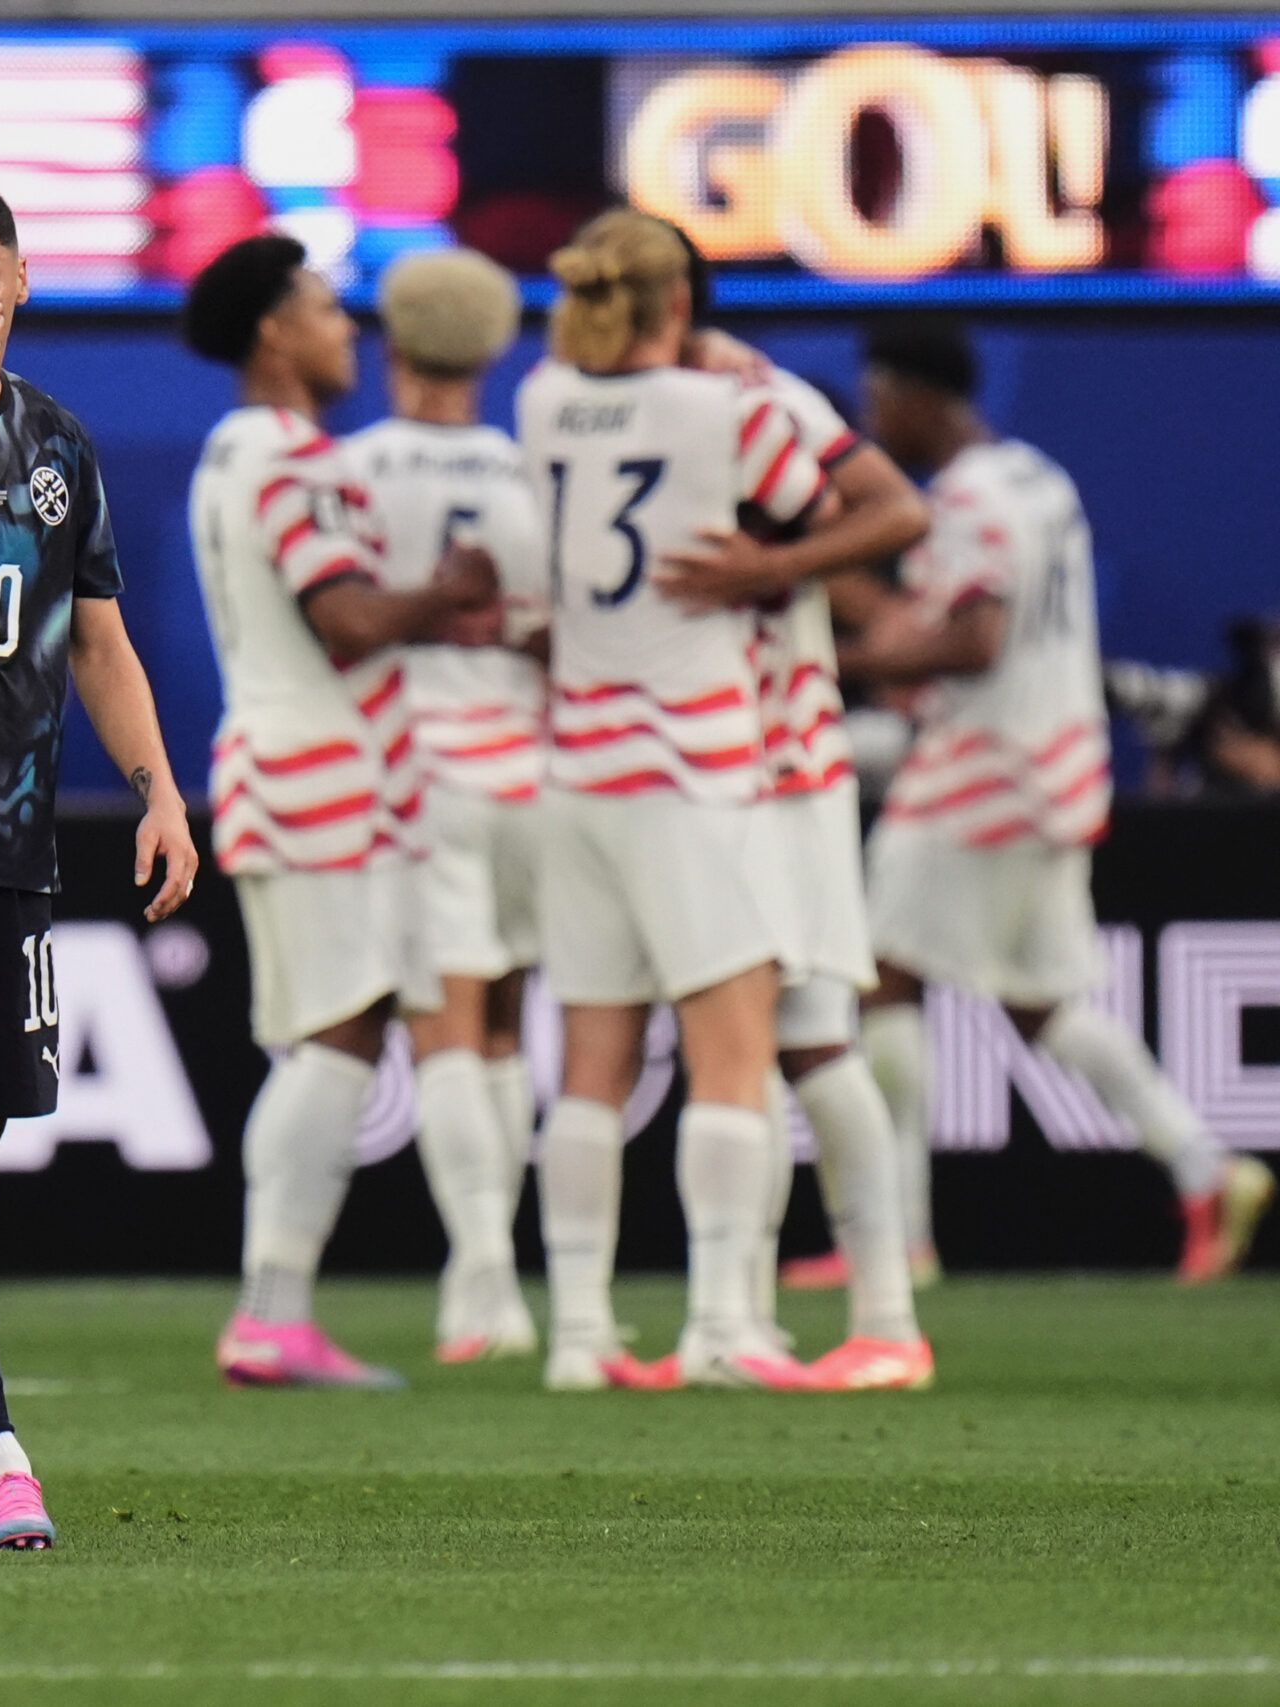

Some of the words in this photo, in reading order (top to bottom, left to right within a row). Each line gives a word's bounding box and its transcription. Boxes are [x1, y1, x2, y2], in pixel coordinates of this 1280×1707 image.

[625, 43, 1109, 281] GOL!
[549, 459, 665, 607] 13
[22, 931, 58, 1032] 10
